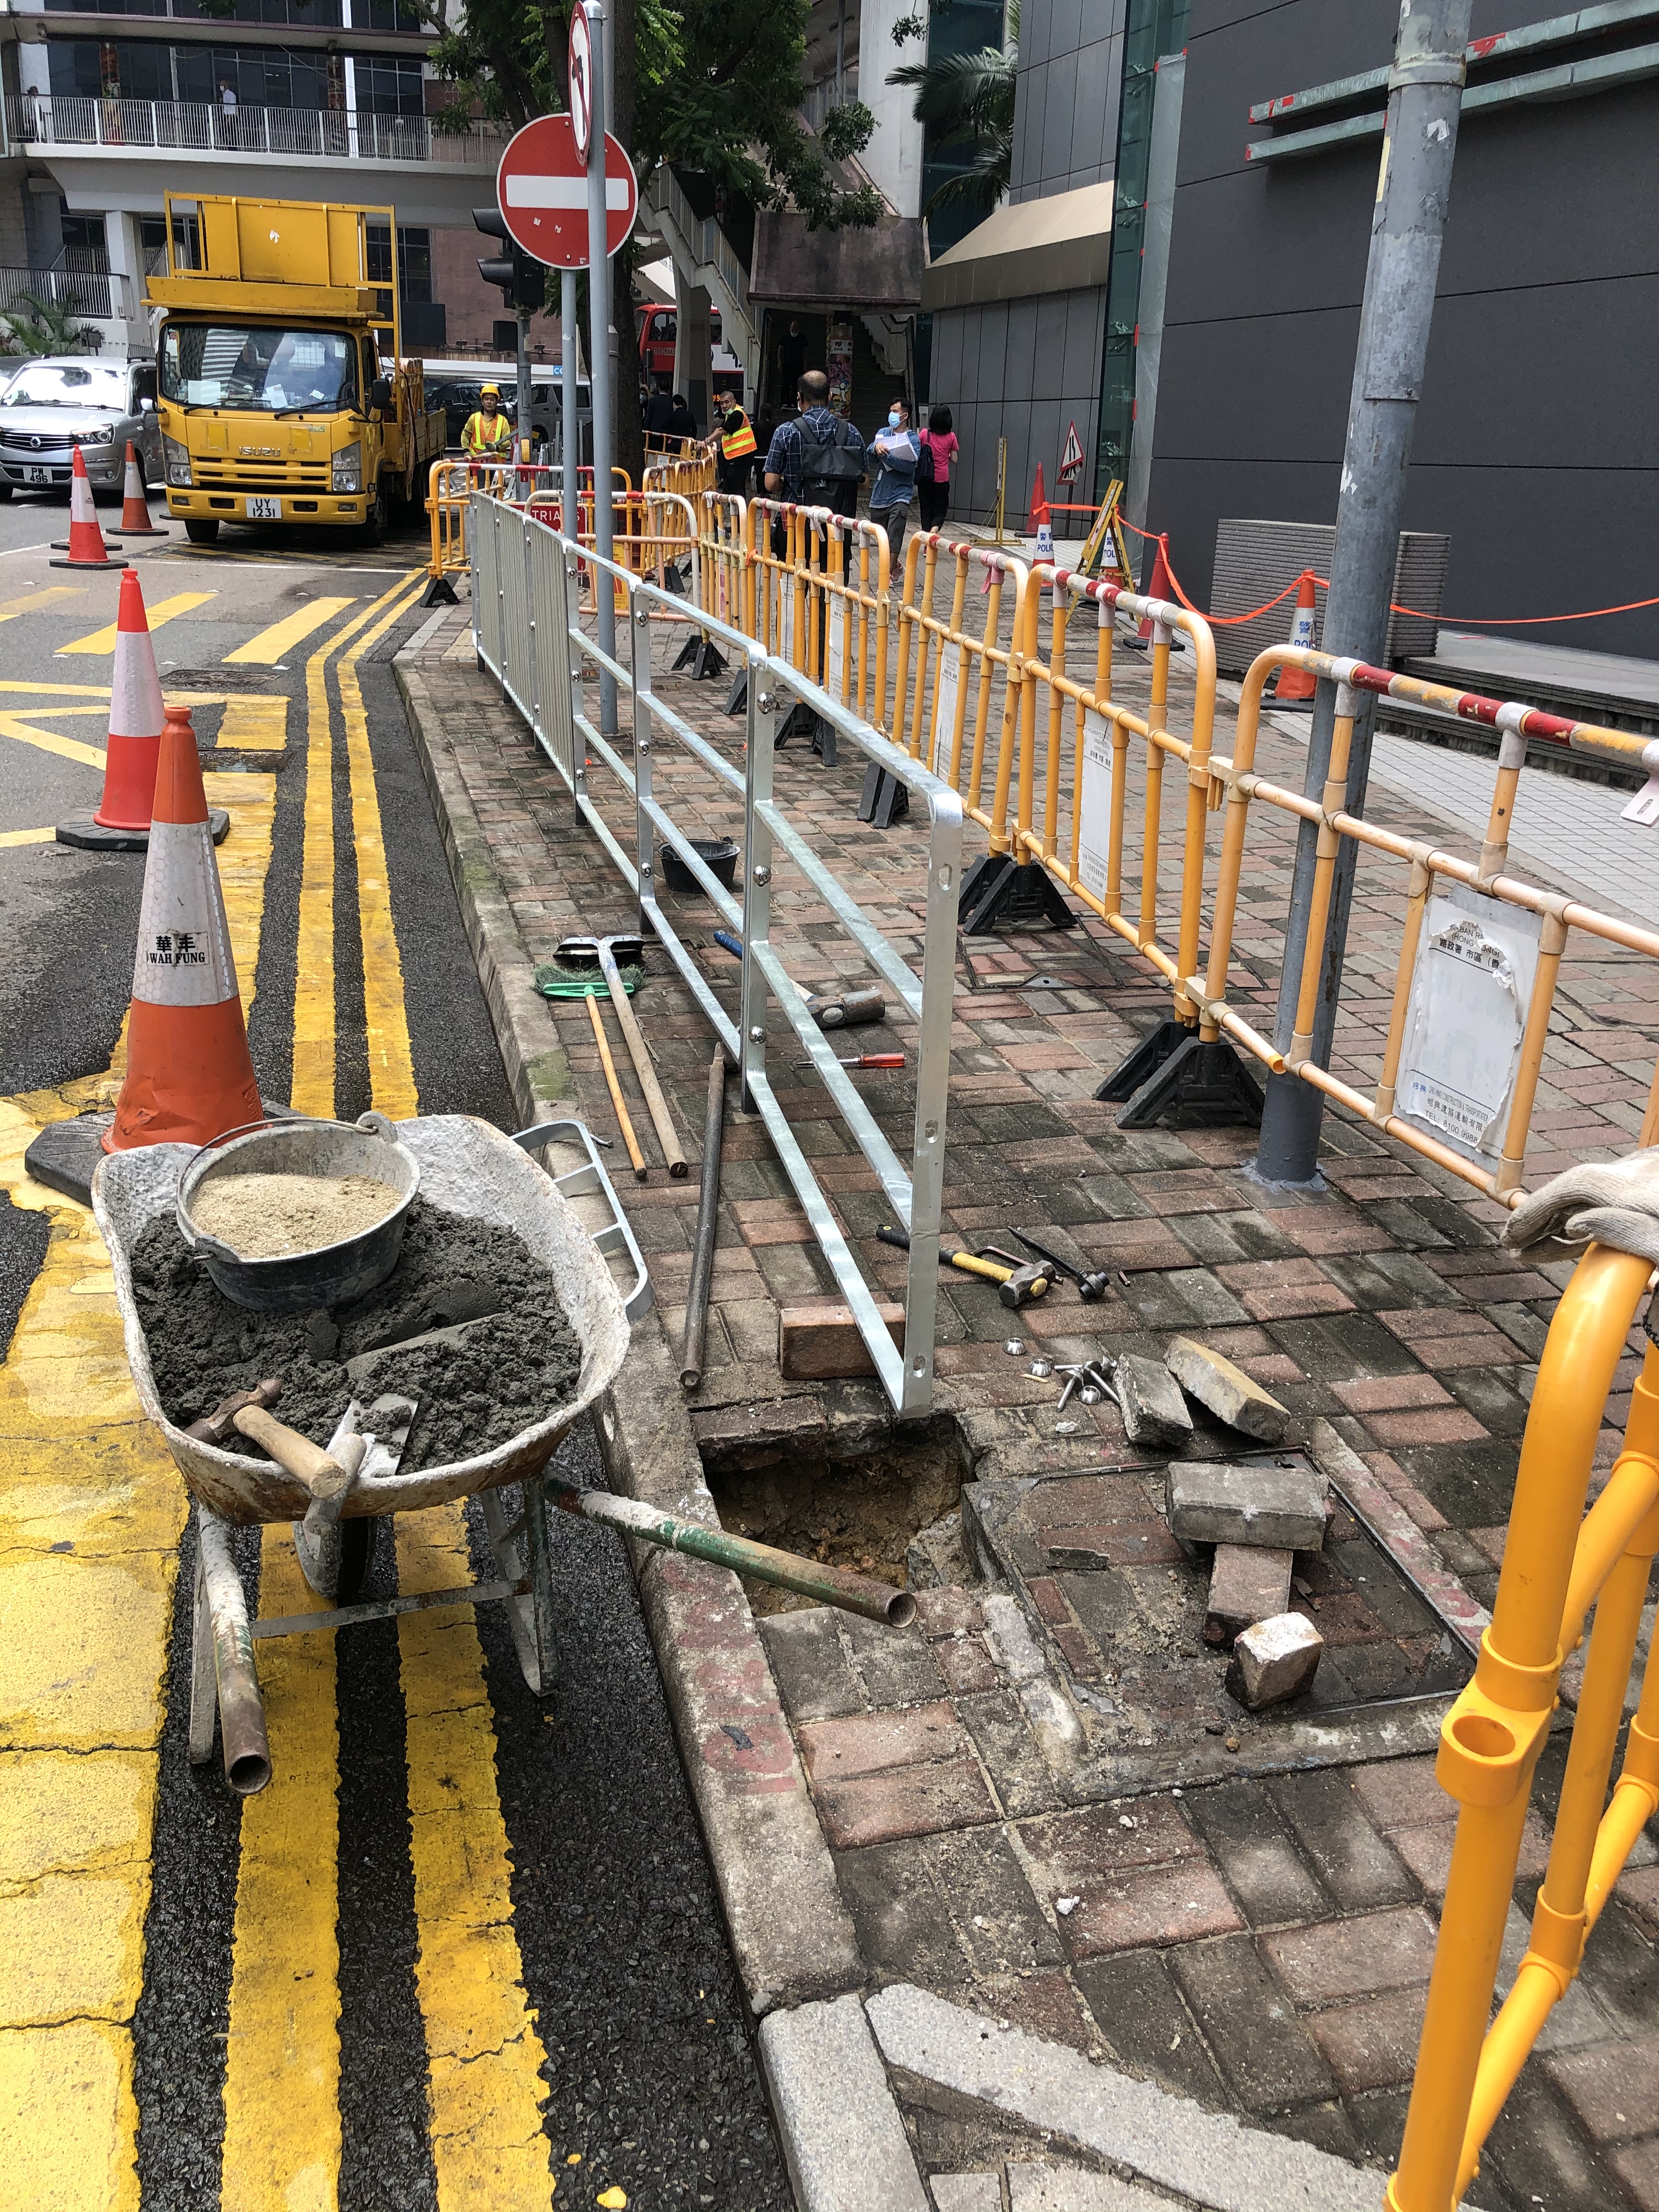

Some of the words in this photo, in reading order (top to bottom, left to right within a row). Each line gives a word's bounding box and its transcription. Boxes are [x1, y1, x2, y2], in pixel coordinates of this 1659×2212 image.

[239, 446, 281, 456] ISUZU
[31, 467, 44, 476] PW
[30, 475, 48, 483] 496
[255, 498, 270, 508] UY
[252, 507, 276, 518] 1231
[1452, 933, 1475, 947] (HONG
[1480, 944, 1500, 958] ONG)
[149, 952, 173, 964] WAH
[175, 952, 206, 964] FUNG
[1443, 1120, 1459, 1135] 8100
[1461, 1130, 1479, 1144] 9988
